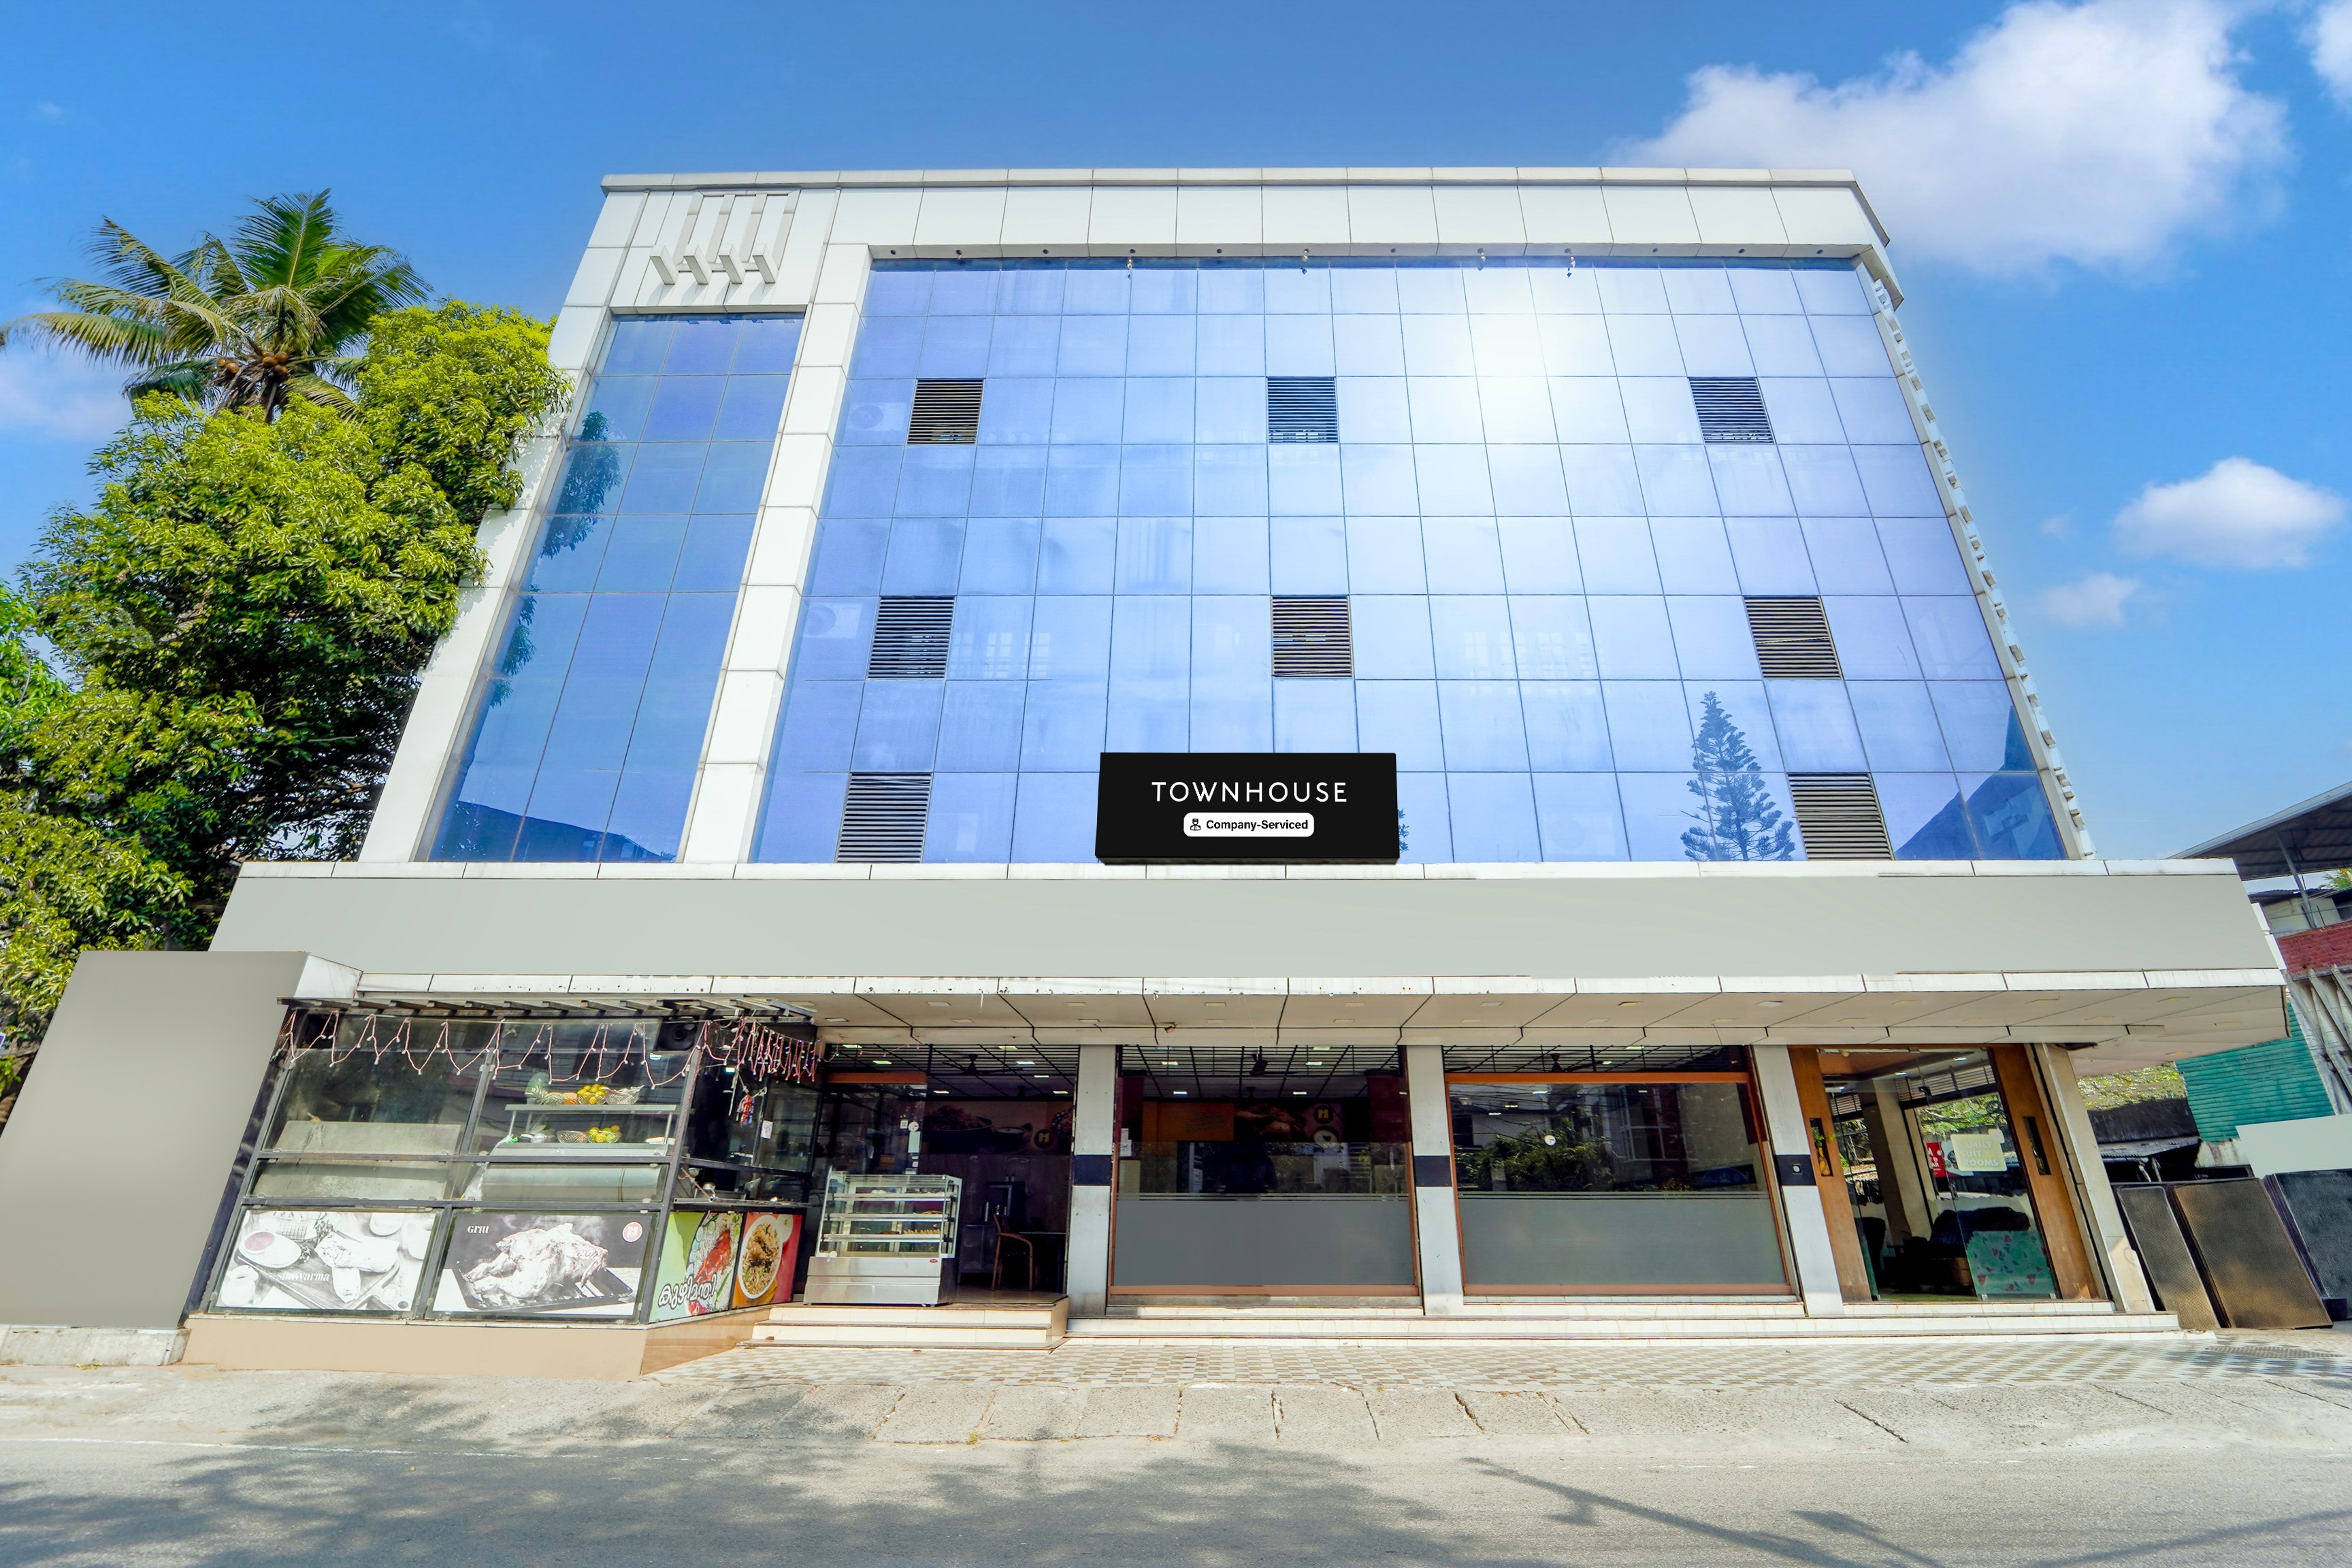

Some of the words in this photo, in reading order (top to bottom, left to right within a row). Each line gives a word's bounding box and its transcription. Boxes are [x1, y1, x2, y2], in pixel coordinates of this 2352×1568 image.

[1152, 781, 1347, 802] TOWNHOUSE
[1206, 819, 1308, 832] Company-Serviced
[467, 1225, 489, 1234] Grill
